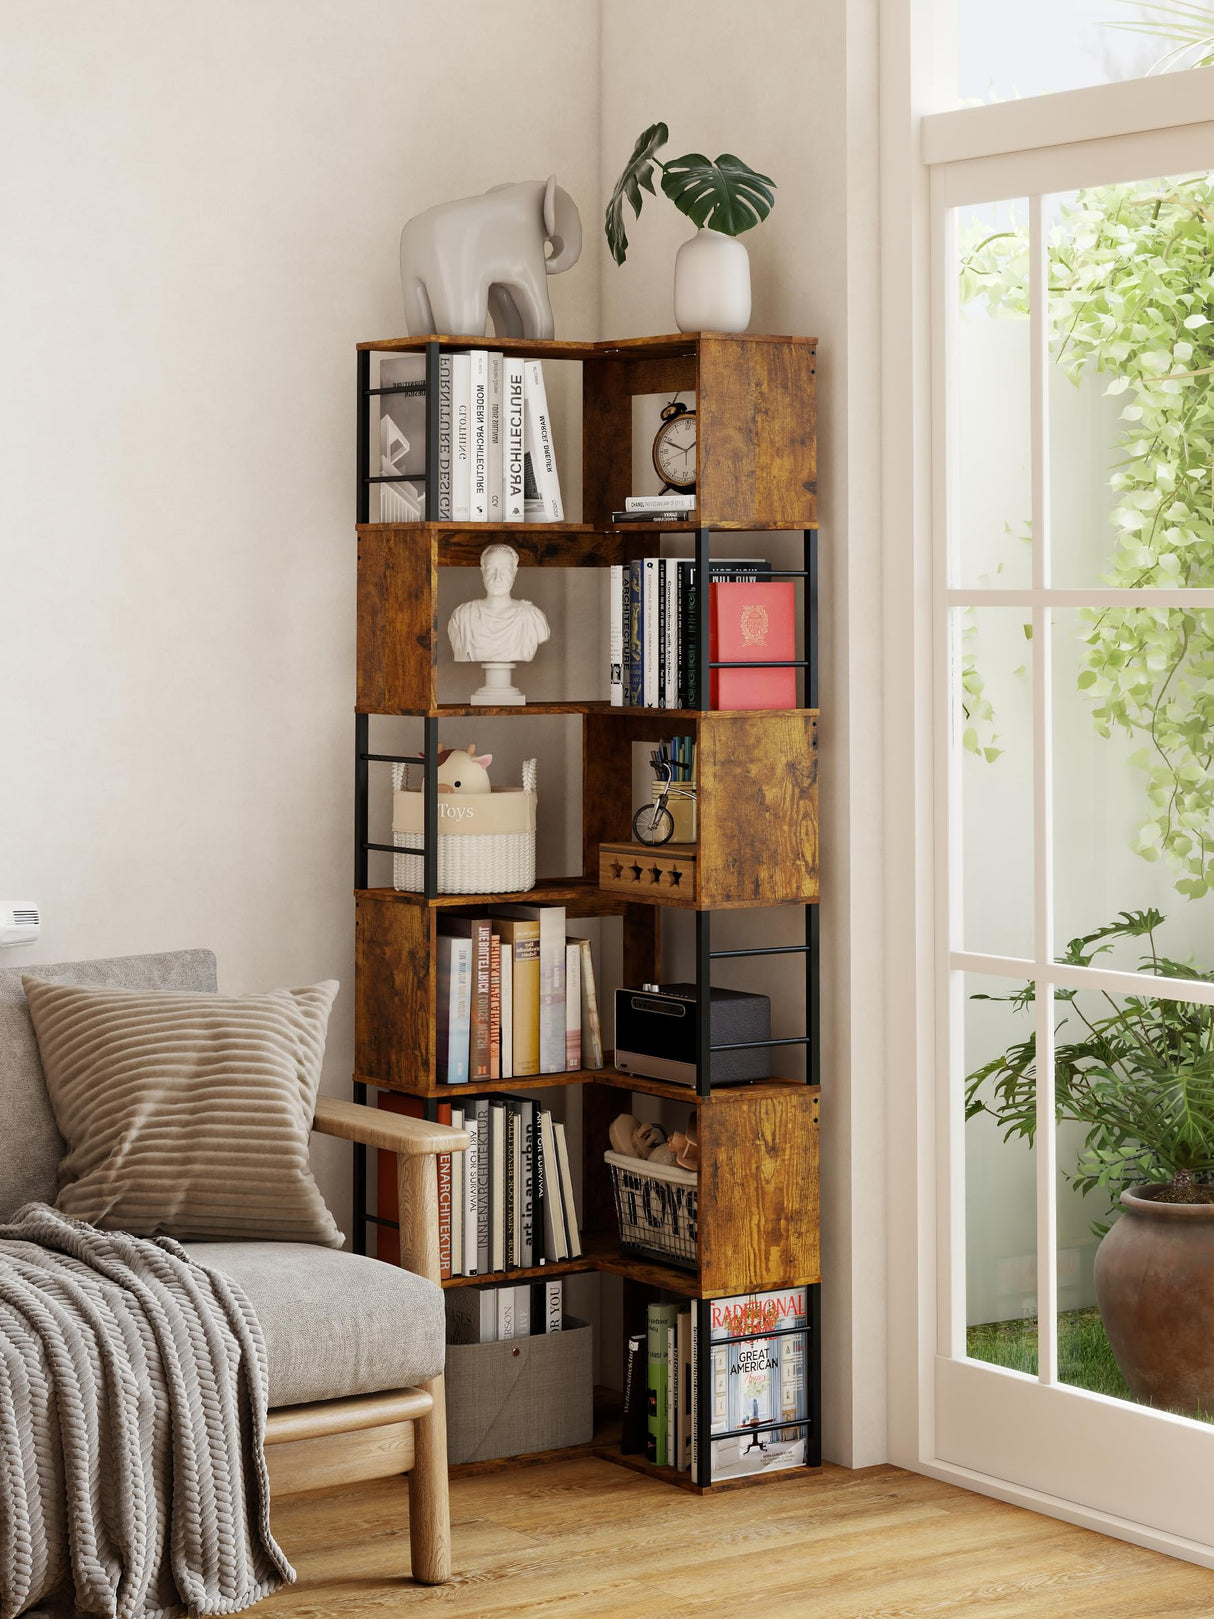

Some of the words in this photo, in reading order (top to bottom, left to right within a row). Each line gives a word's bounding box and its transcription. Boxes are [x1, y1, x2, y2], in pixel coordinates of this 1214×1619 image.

[438, 804, 474, 822] Toys
[522, 1124, 532, 1172] urban
[478, 1111, 488, 1249] INNENARCHITEKTUR
[526, 1178, 532, 1198] an
[522, 1202, 532, 1218] in
[523, 1221, 532, 1246] art
[550, 1287, 560, 1315] YOU
[710, 1294, 806, 1328] RADITIONAL
[730, 1318, 778, 1347] HOME
[730, 1357, 779, 1376] AMERICAN
[739, 1348, 770, 1362] GREAT
